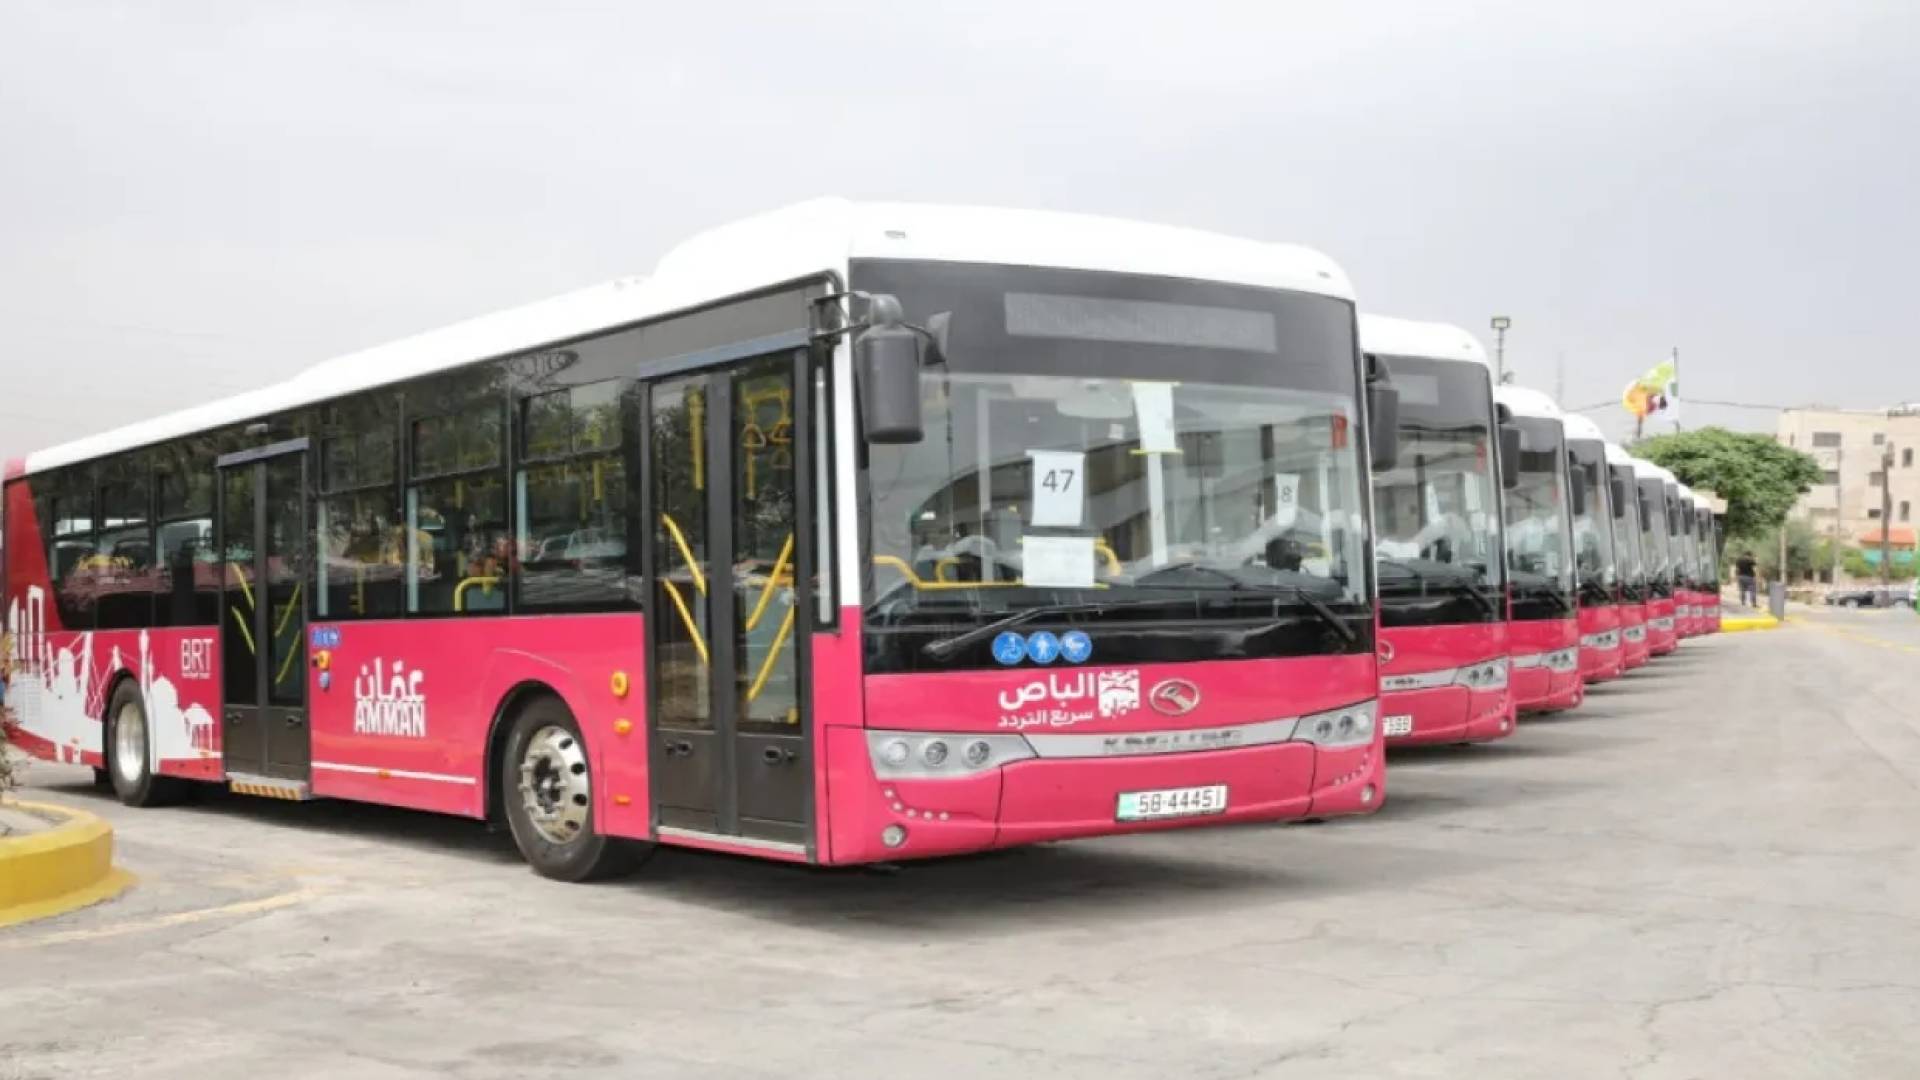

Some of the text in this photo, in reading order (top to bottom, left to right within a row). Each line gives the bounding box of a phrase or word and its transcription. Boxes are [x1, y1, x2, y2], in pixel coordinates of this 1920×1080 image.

[1042, 469, 1075, 492] 47
[181, 638, 213, 671] BRT
[999, 672, 1095, 710] الباص
[354, 700, 425, 737] AMMAN
[998, 710, 1093, 729] سريع التردد
